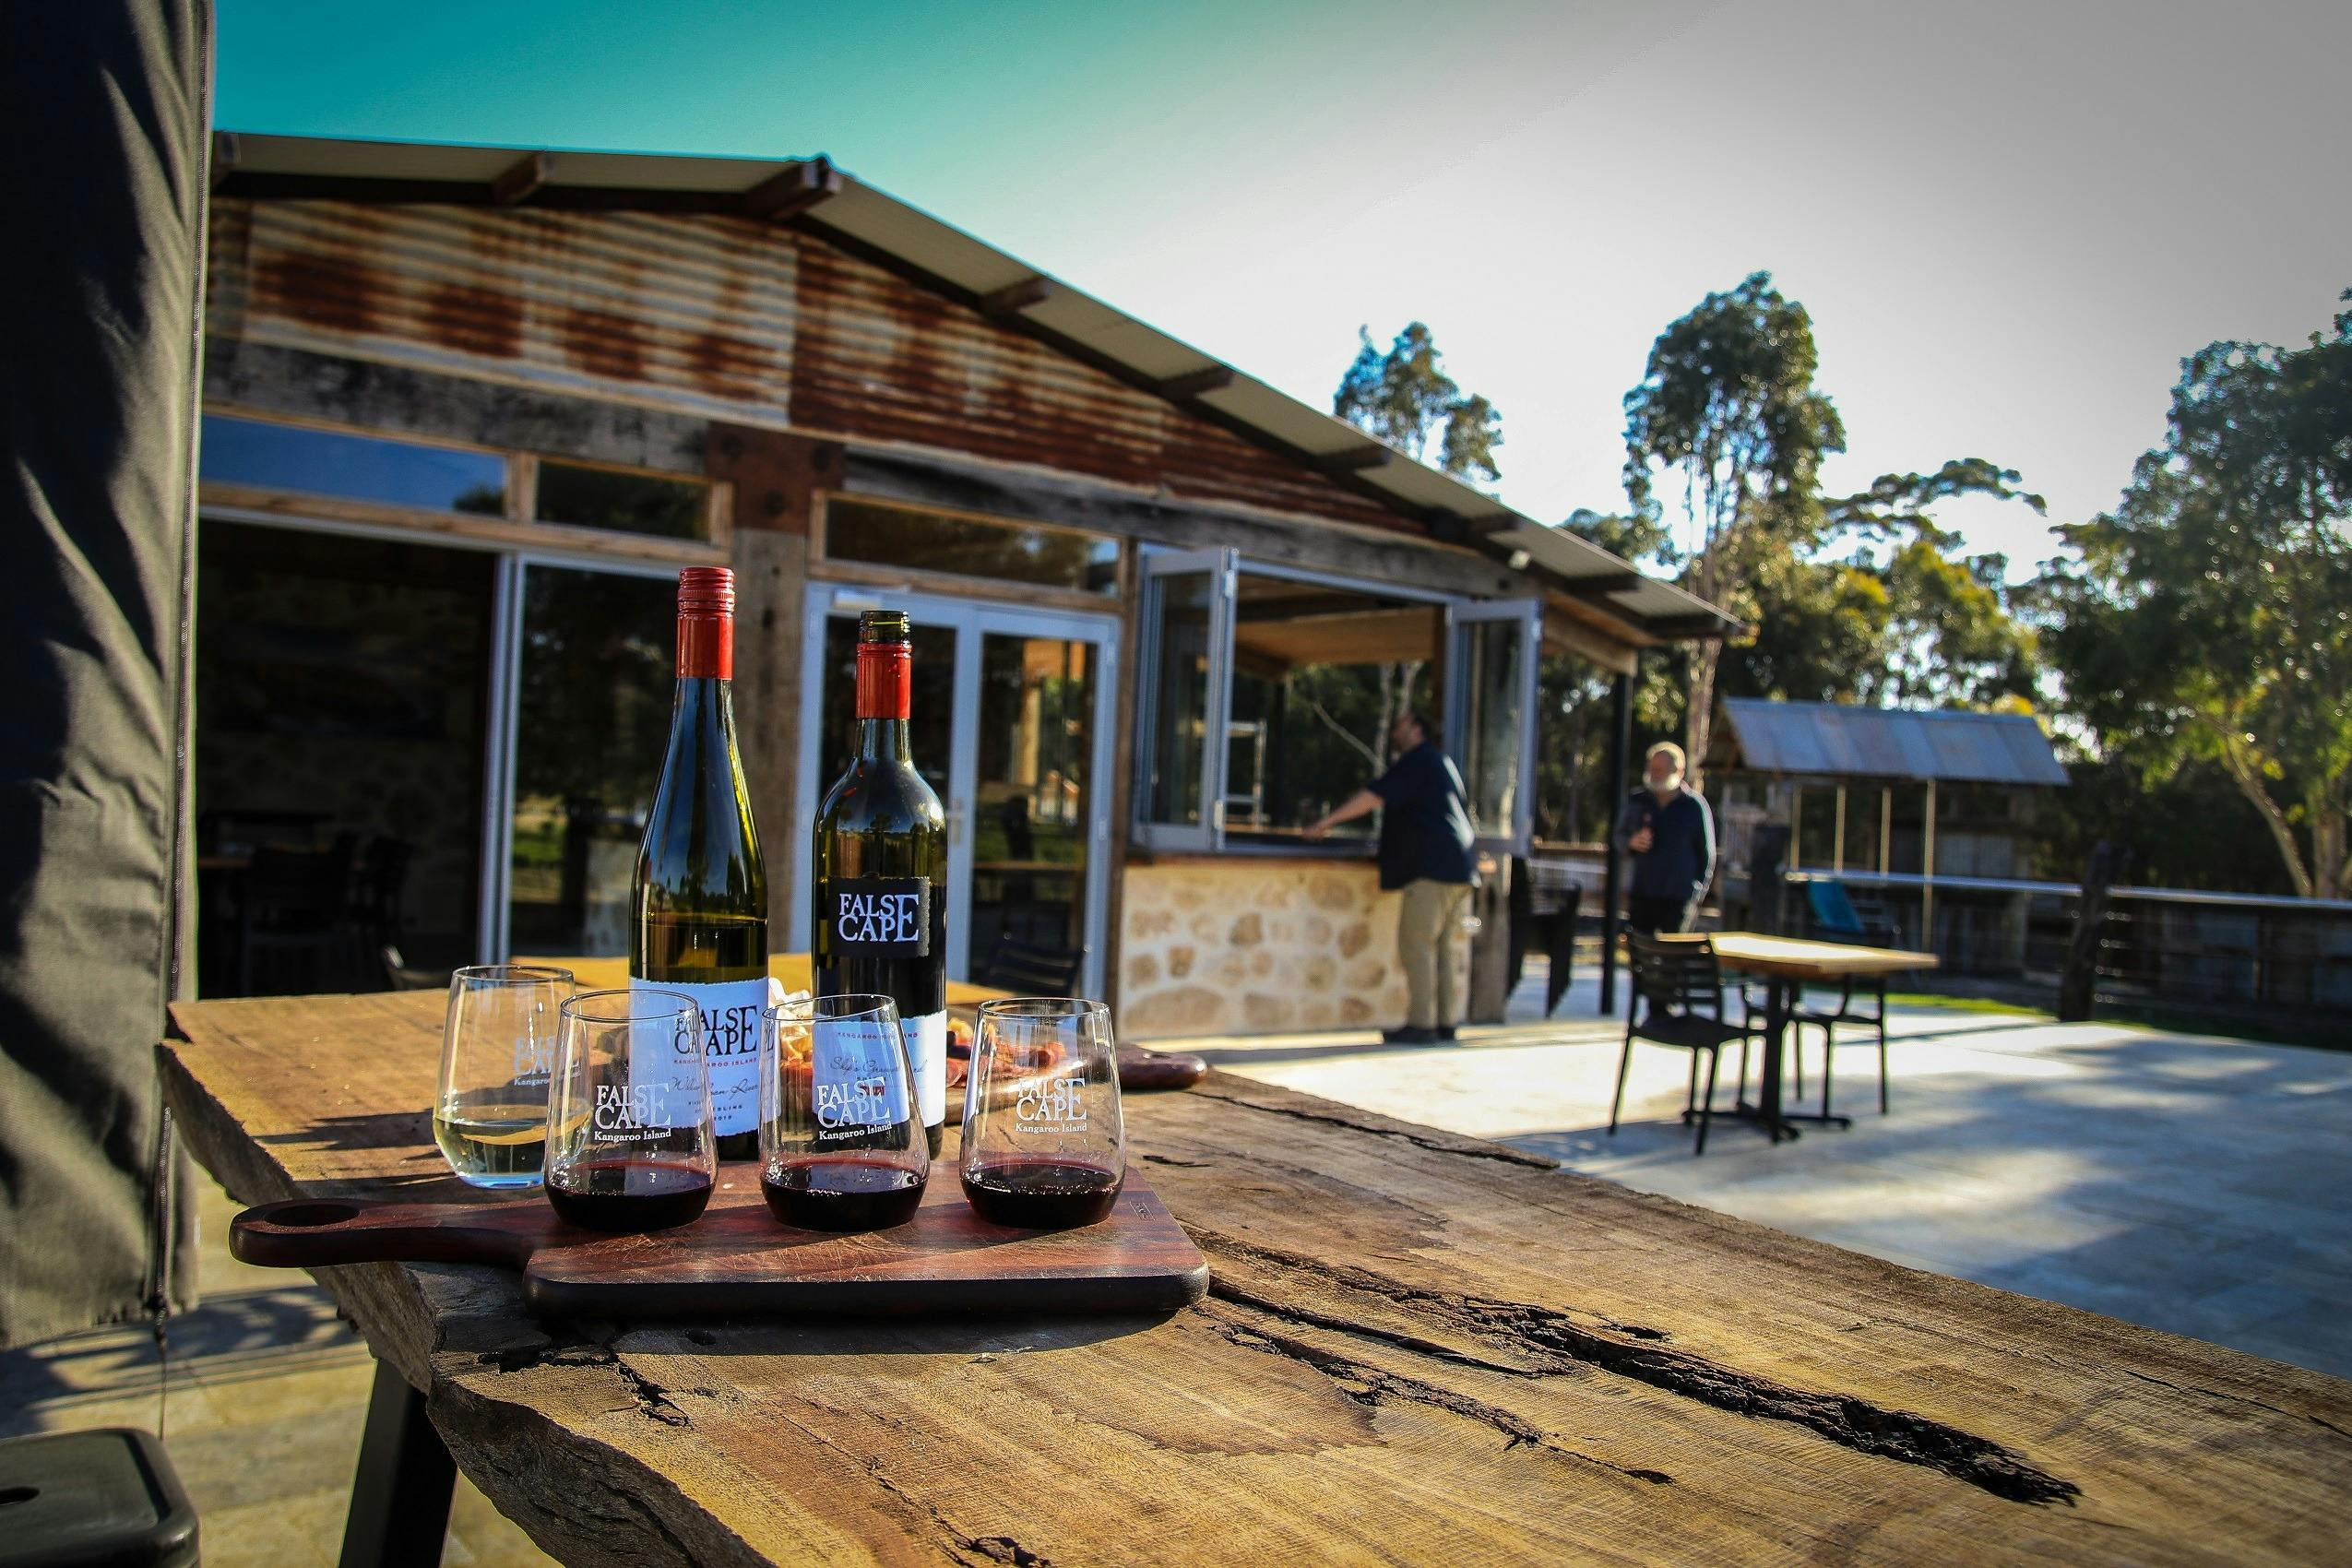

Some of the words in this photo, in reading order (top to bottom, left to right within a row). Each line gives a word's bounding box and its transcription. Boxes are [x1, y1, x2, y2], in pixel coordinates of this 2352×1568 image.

[839, 893, 919, 920] FALSE
[838, 913, 919, 942] CAPE
[674, 1005, 757, 1033] FALSE
[674, 1028, 757, 1056] CAPE
[514, 1077, 549, 1087] Kangaro
[595, 1082, 671, 1108] FALSE
[816, 1076, 886, 1106] FALSE
[1017, 1077, 1086, 1099] FALSE
[595, 1103, 671, 1130] CAPE
[817, 1100, 890, 1129] CAPE
[1016, 1094, 1087, 1121] CAPE
[594, 1131, 641, 1143] Kangaroo
[643, 1128, 671, 1140] Island
[818, 1129, 865, 1140] Kangaroo
[867, 1120, 892, 1134] Island
[1016, 1123, 1060, 1134] Kangaroo
[1062, 1123, 1087, 1133] Island
